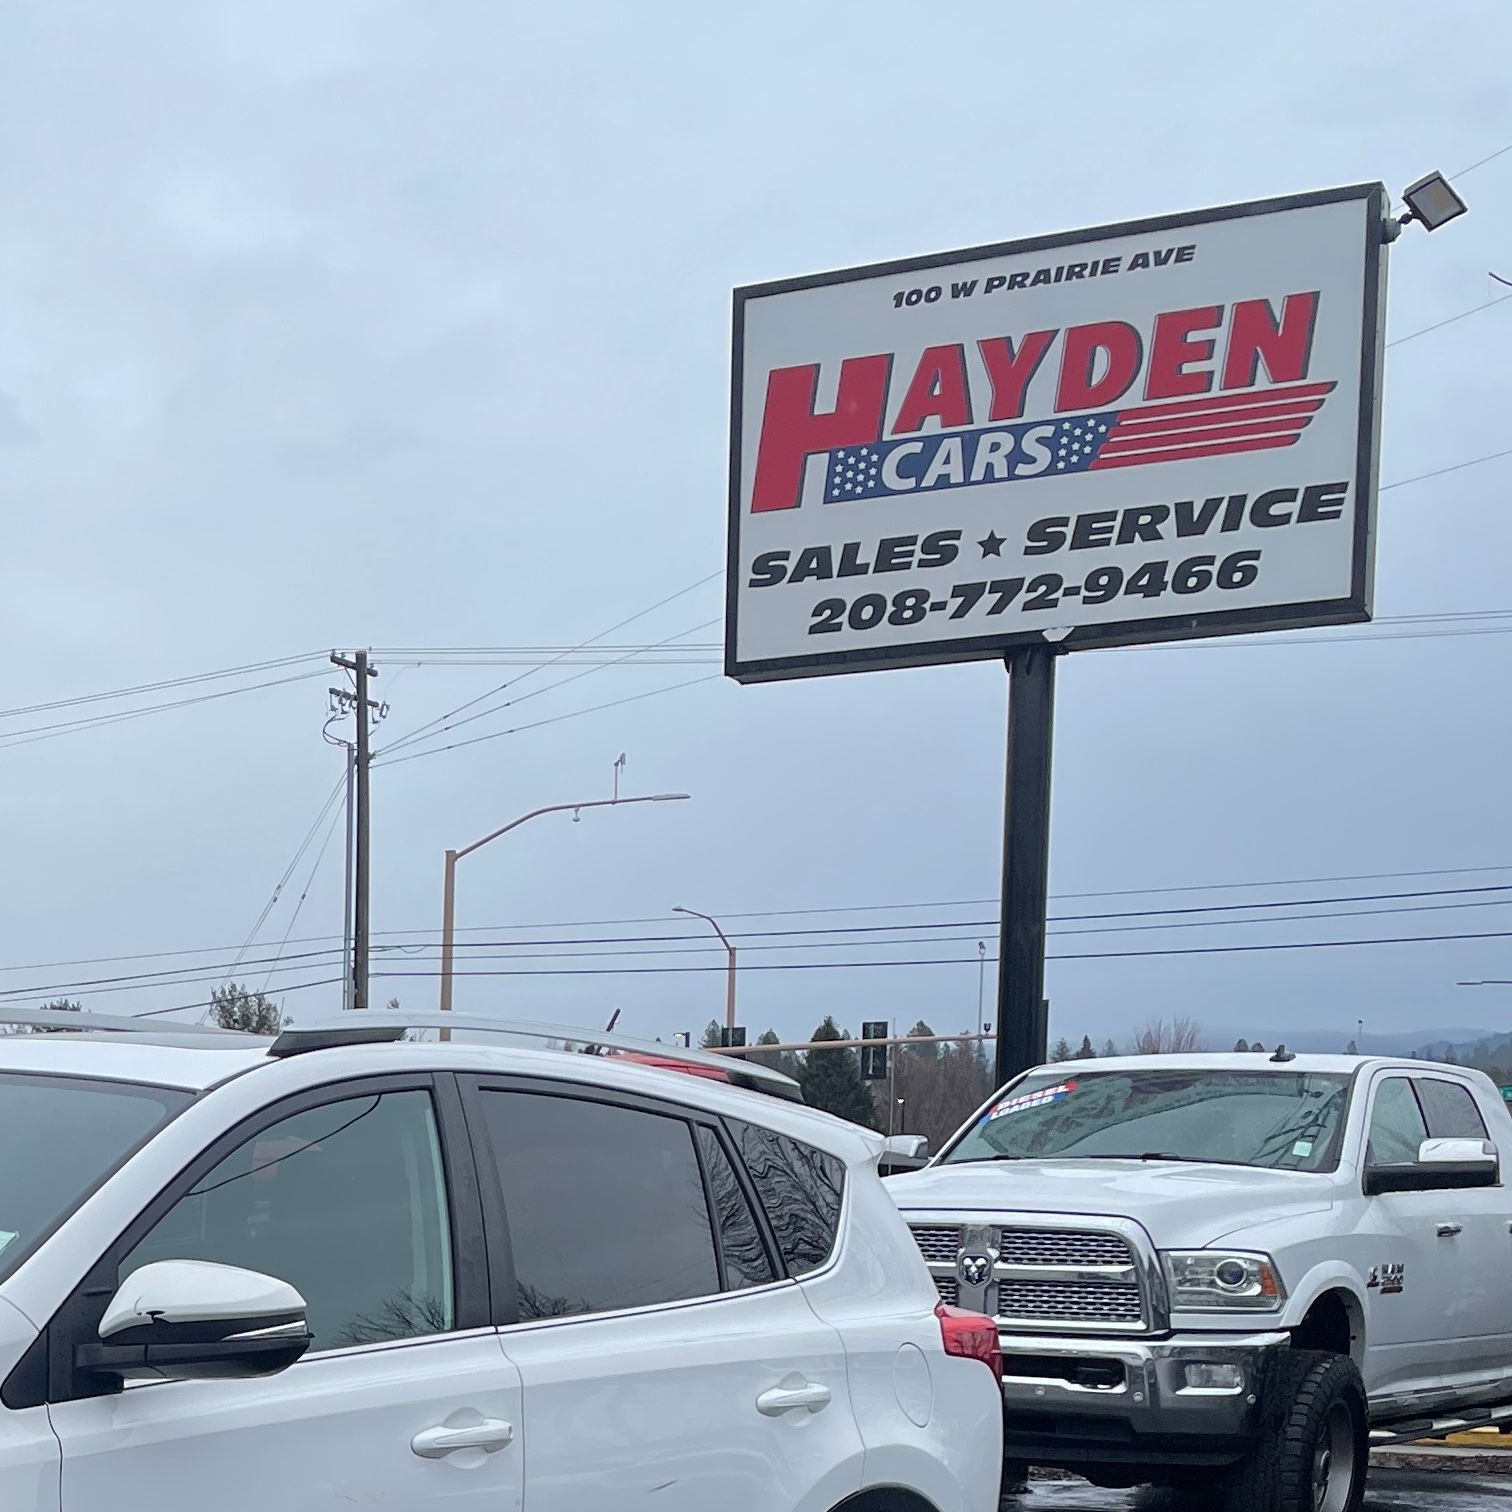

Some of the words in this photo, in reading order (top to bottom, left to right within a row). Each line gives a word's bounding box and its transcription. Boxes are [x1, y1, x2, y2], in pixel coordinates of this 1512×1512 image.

[892, 285, 943, 310] 100
[950, 276, 981, 299] W
[983, 257, 1122, 294] PRAIRIE
[1127, 244, 1197, 269] AVE
[750, 291, 1321, 515] HAYDEN
[880, 424, 1058, 493] CARS
[748, 528, 965, 589] SALES
[1023, 482, 1349, 556] SERVICE
[807, 551, 1261, 635] 208-772-9466
